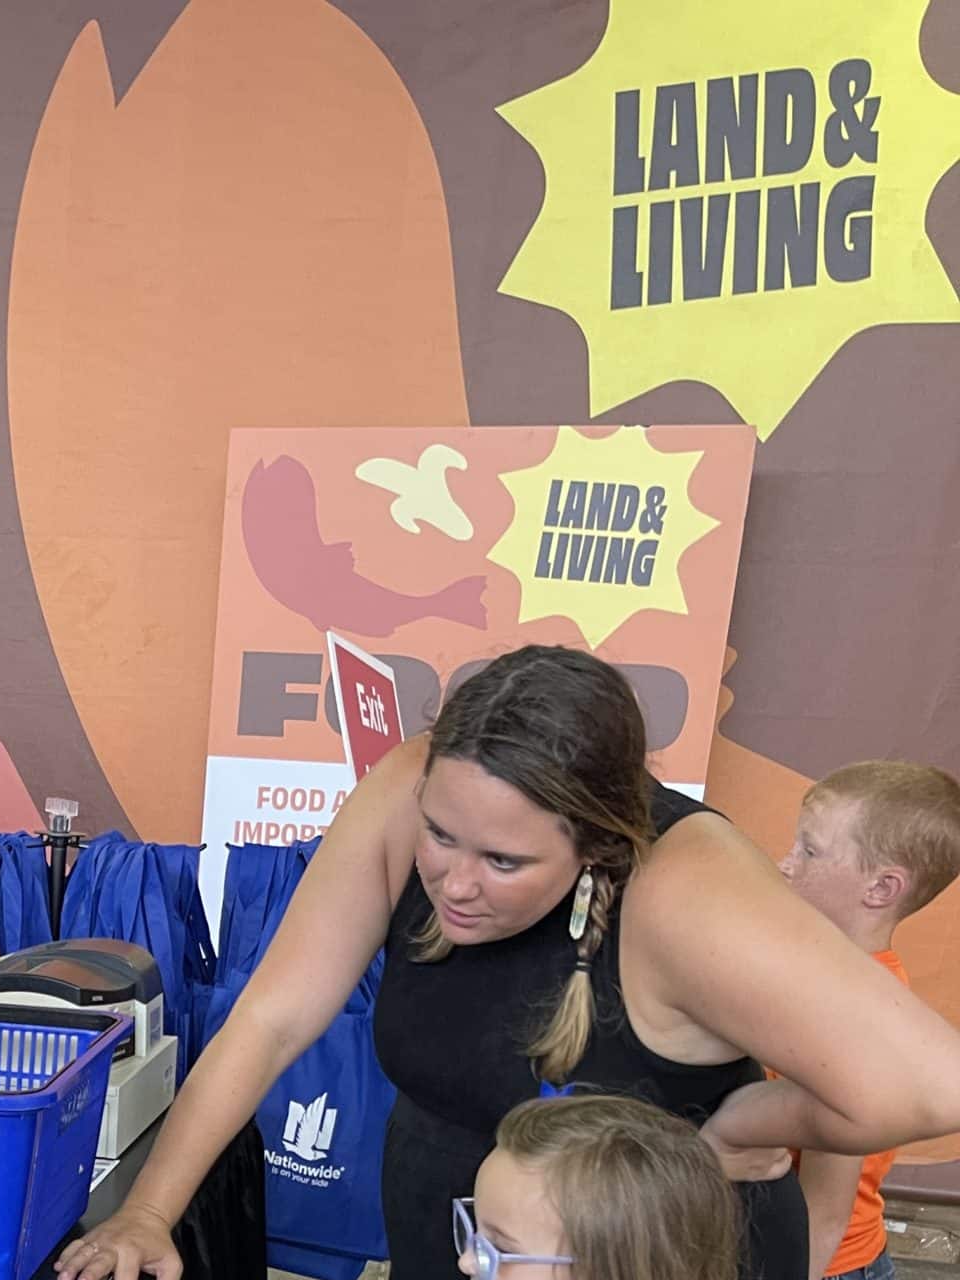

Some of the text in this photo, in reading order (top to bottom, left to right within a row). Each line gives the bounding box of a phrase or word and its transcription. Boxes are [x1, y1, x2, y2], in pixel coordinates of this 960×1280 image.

[610, 174, 876, 312] LIVING
[534, 531, 660, 587] LIVING
[355, 681, 389, 737] Exit
[256, 785, 326, 813] FOOD
[271, 1166, 329, 1188] is on your side
